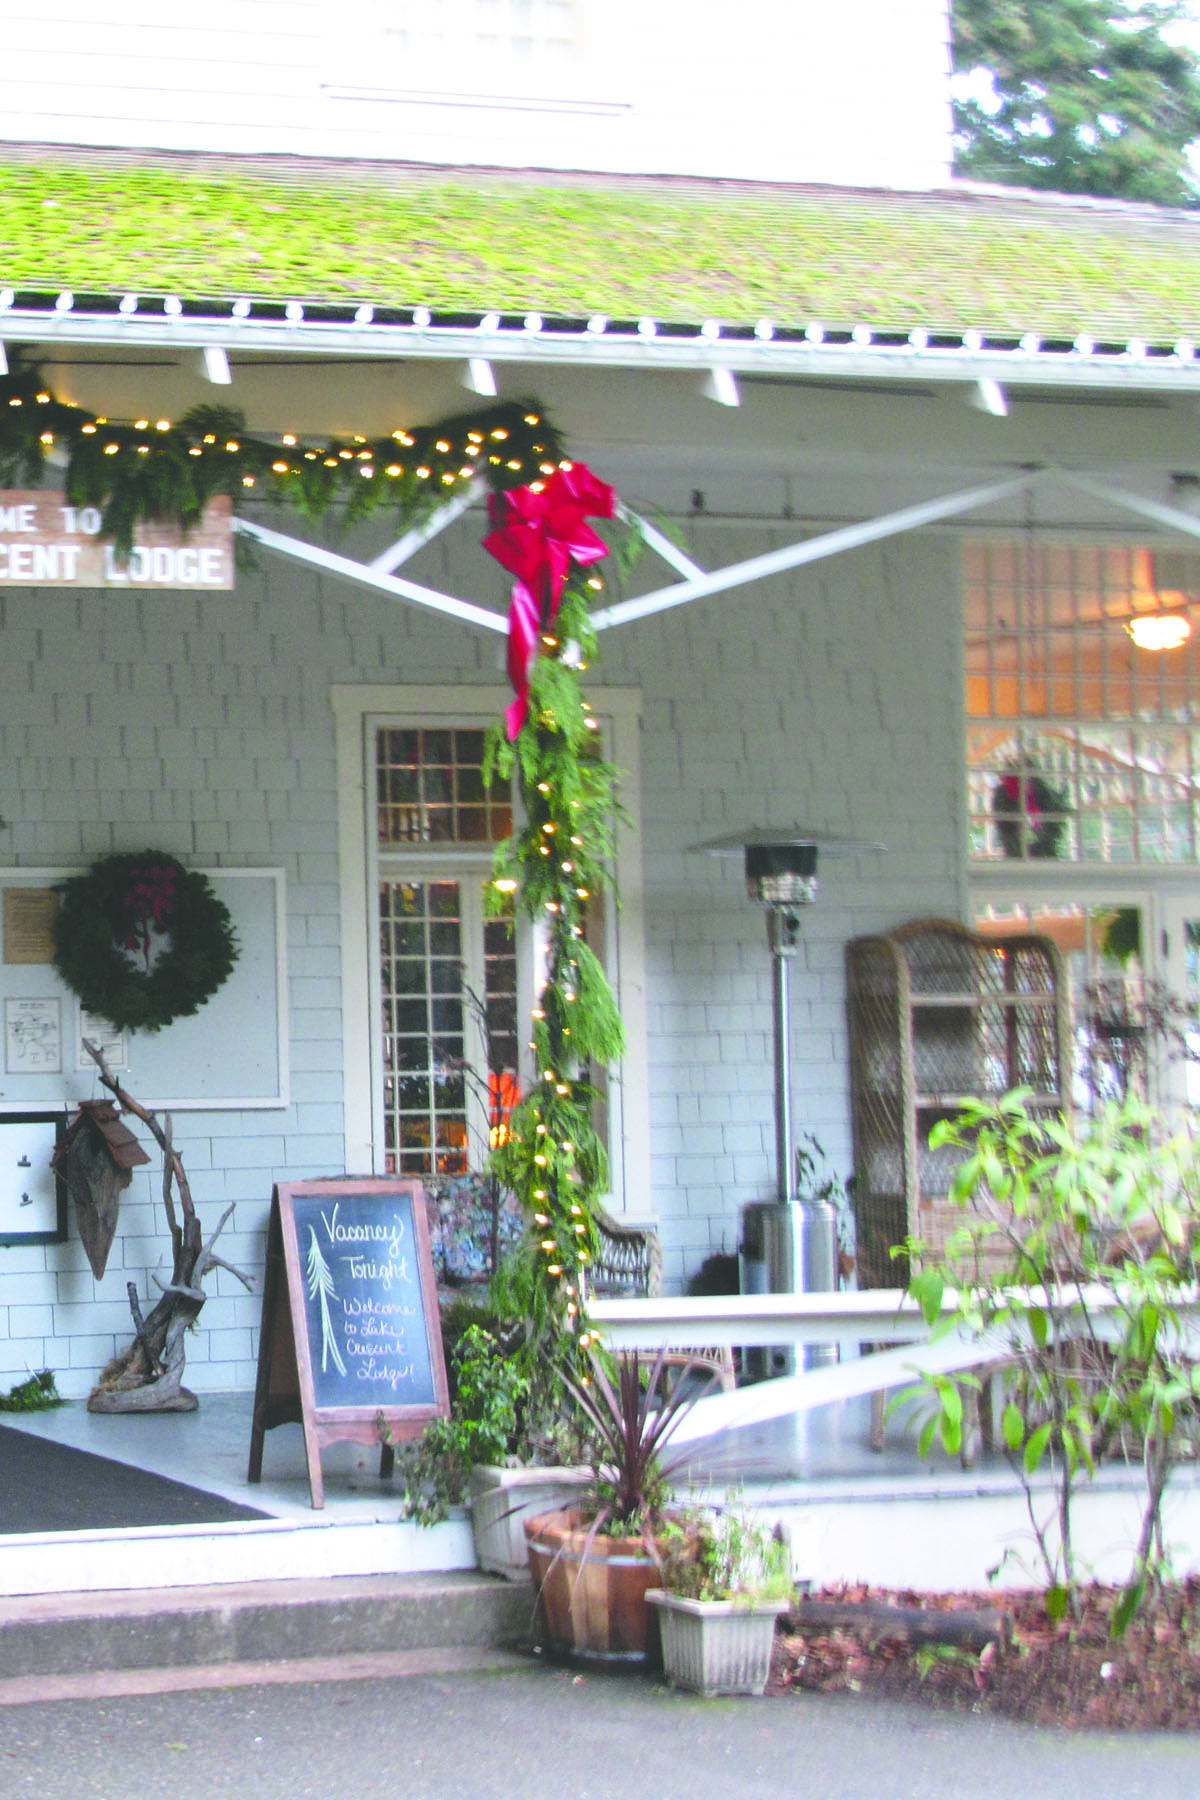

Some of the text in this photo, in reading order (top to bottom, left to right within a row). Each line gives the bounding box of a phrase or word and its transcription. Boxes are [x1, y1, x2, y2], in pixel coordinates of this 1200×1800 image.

[58, 506, 102, 535] TO
[103, 544, 225, 584] LODGE
[320, 1202, 404, 1259] Vacancy
[340, 1254, 412, 1291] Tonight
[343, 1296, 417, 1316] Welcome
[344, 1316, 405, 1337] to Lake
